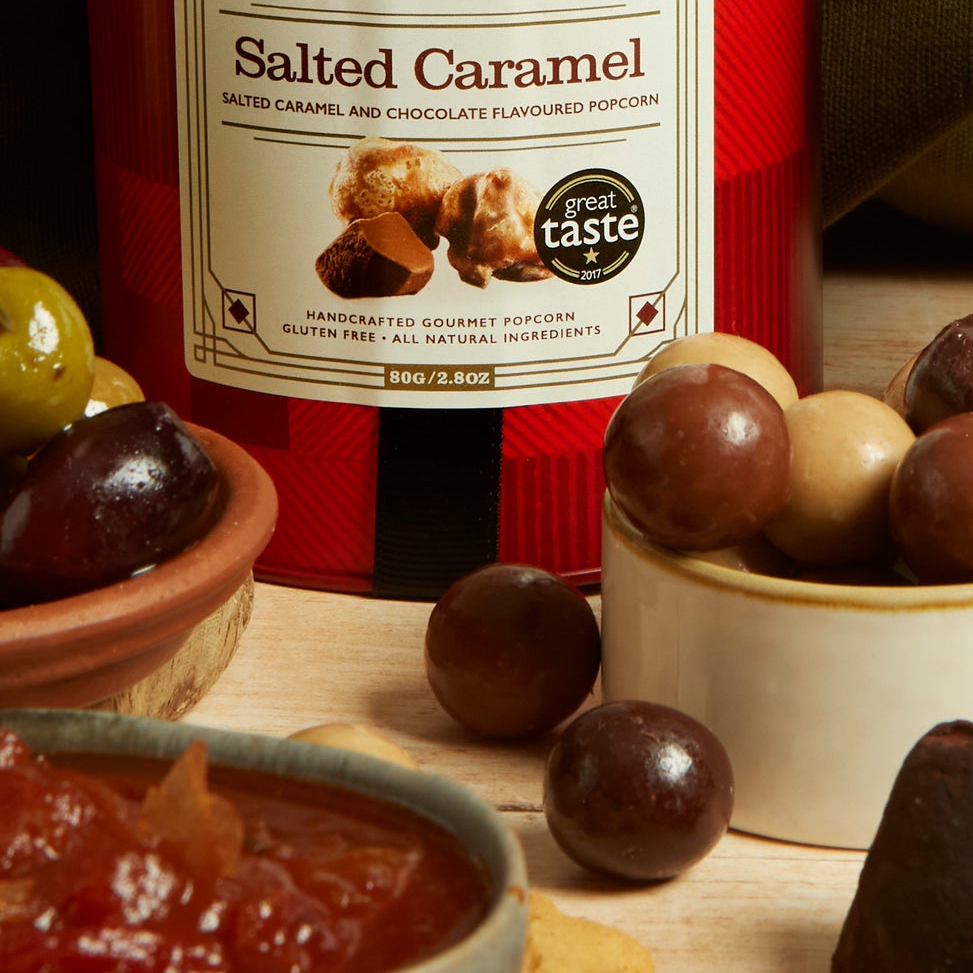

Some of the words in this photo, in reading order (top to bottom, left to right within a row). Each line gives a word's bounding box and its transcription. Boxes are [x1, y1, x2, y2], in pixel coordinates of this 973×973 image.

[235, 36, 398, 89] Salted
[414, 37, 645, 91] Caramel
[222, 92, 271, 109] SALTED
[275, 99, 345, 117] CARAMEL
[349, 106, 381, 119] AND
[386, 107, 487, 120] CHOCOLATE
[492, 102, 584, 119] FLAVOURED
[589, 93, 659, 113] POPCORN
[565, 191, 617, 219] great
[541, 213, 639, 248] taste
[580, 269, 602, 281] 2017
[306, 310, 415, 327] HANDCRAFTED
[422, 317, 497, 328] GOURMET
[504, 312, 575, 327] POPCORN
[282, 324, 337, 339] GLUTEN
[343, 330, 376, 343] FREE
[392, 334, 419, 344] ALL
[426, 334, 497, 344] NATURAL
[504, 325, 601, 343] INGREDIENTS
